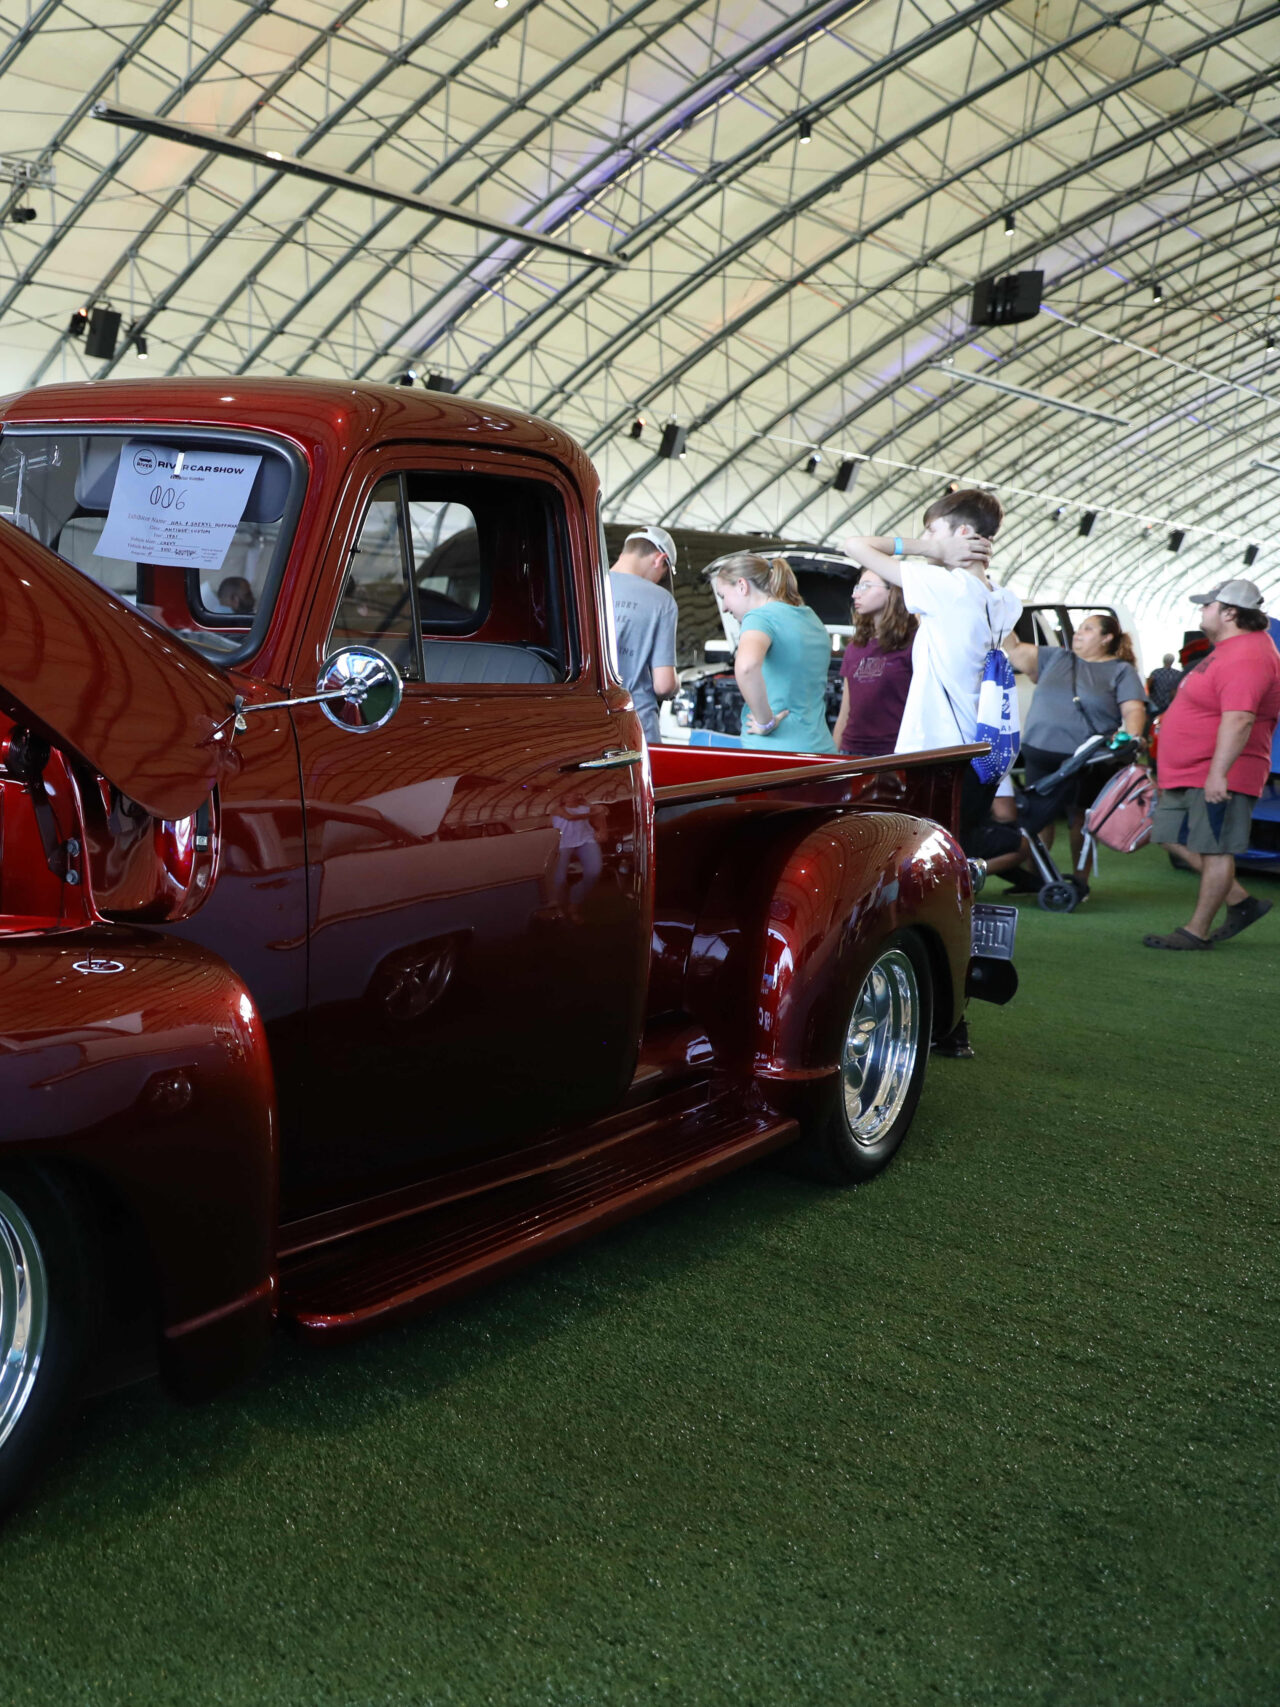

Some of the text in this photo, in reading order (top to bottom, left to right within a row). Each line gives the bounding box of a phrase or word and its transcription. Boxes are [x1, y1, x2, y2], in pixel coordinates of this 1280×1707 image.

[158, 460, 189, 471] RIVR
[190, 465, 211, 473] CAR
[150, 485, 188, 510] 006
[615, 600, 639, 610] HORT
